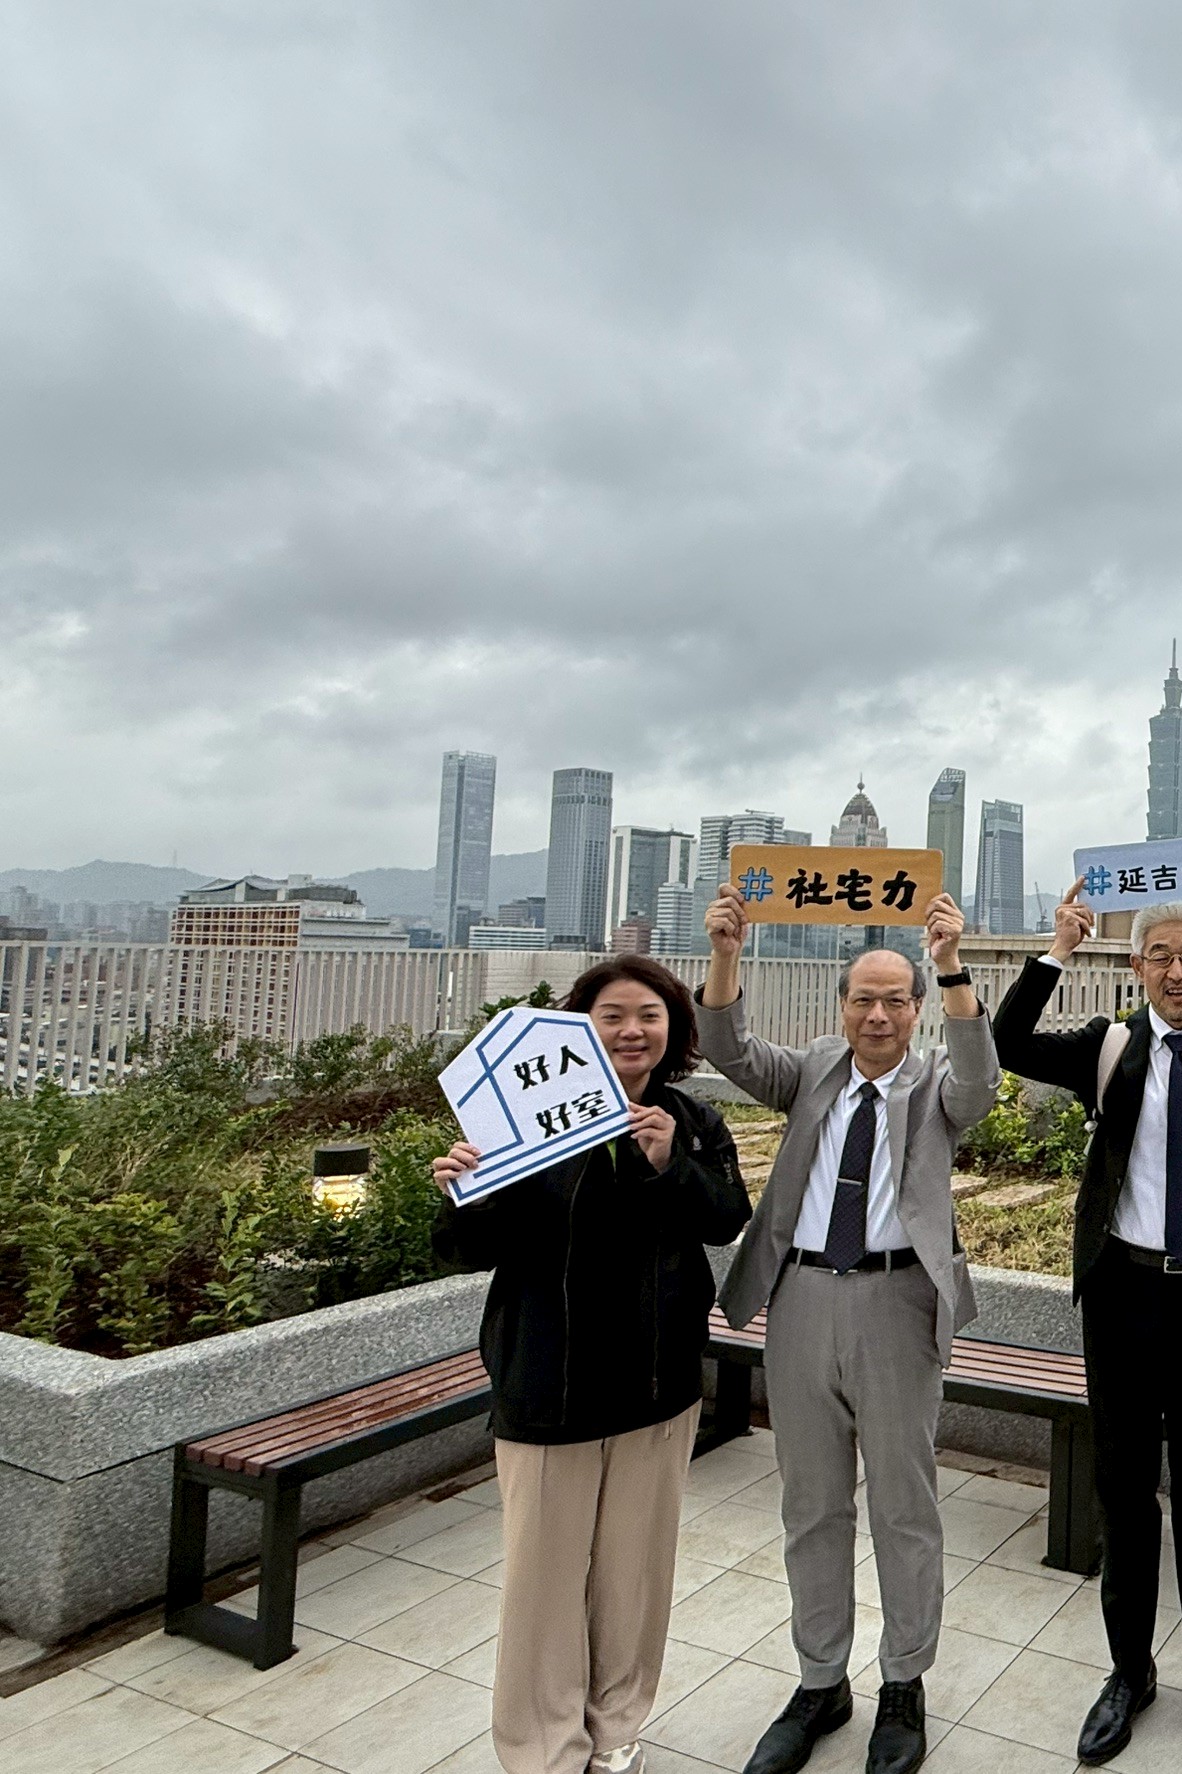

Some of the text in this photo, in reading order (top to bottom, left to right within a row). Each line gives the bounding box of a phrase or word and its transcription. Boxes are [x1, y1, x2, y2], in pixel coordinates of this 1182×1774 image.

[738, 867, 917, 911] #社宅力
[513, 1045, 588, 1090] 好人
[535, 1089, 611, 1139] 好室
